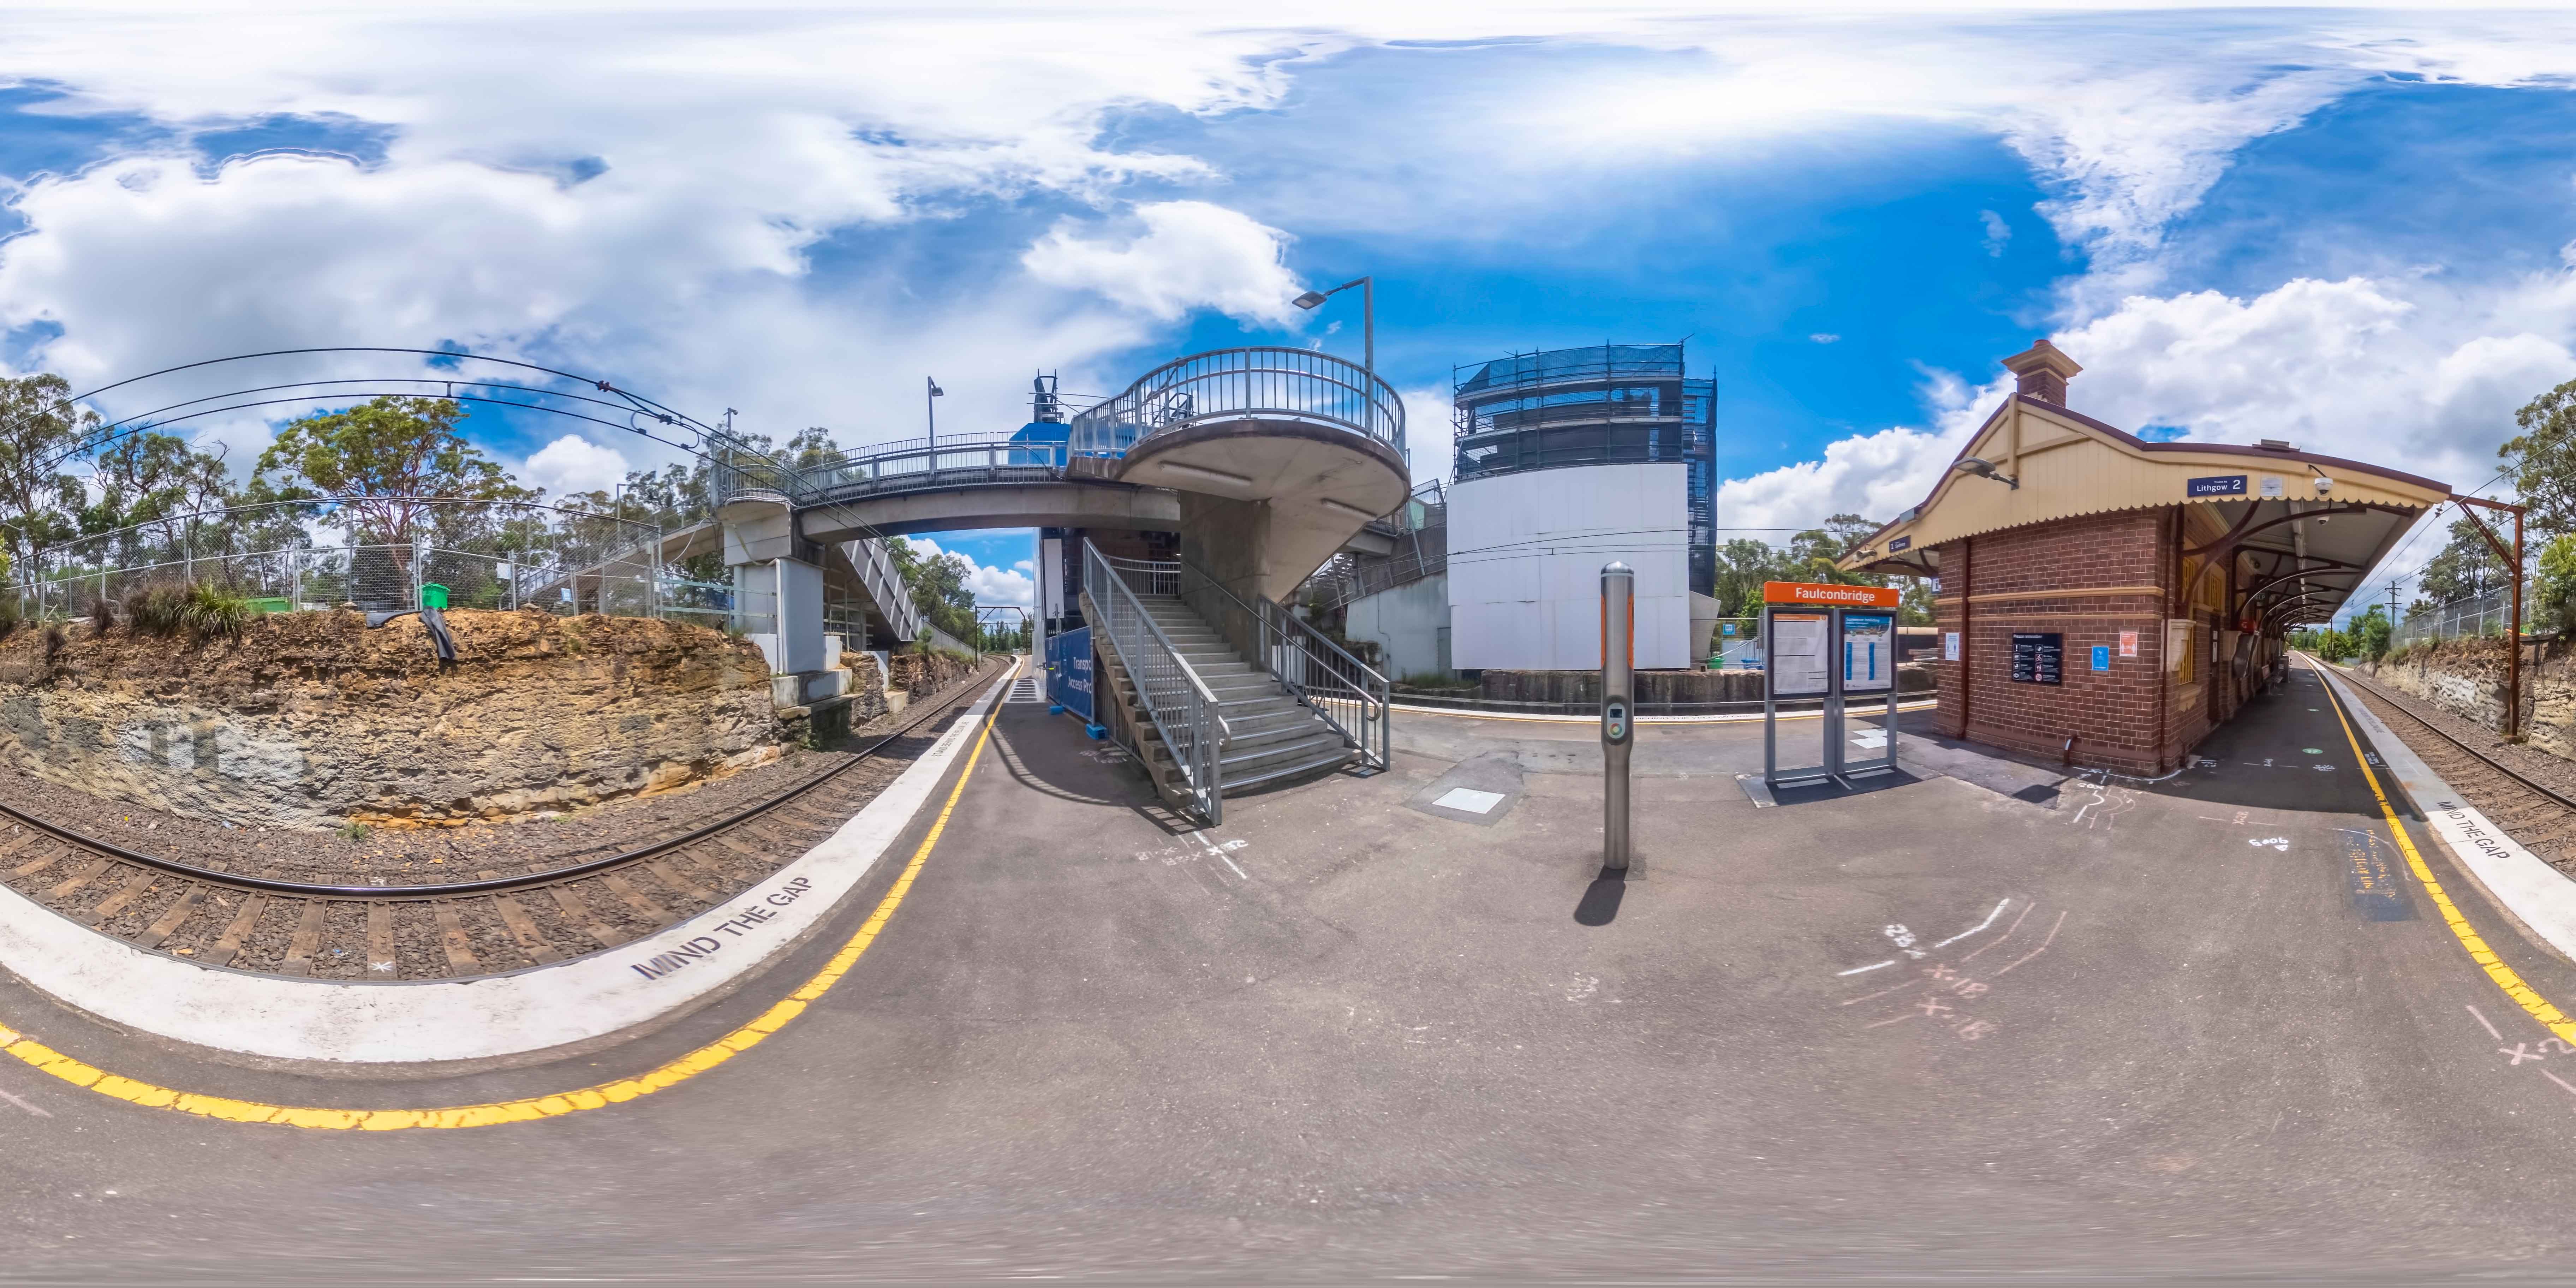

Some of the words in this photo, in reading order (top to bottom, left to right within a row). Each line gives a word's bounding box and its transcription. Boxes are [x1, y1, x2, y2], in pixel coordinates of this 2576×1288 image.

[2233, 479, 2241, 489] 2
[1796, 588, 1875, 603] Faulconbridge
[1068, 675, 1083, 691] Access
[2437, 801, 2465, 819] MIND
[2463, 820, 2486, 838] THE
[2475, 839, 2510, 859] GAP
[631, 936, 721, 980] MIND
[712, 906, 777, 936] THE
[766, 877, 812, 906] GAP
